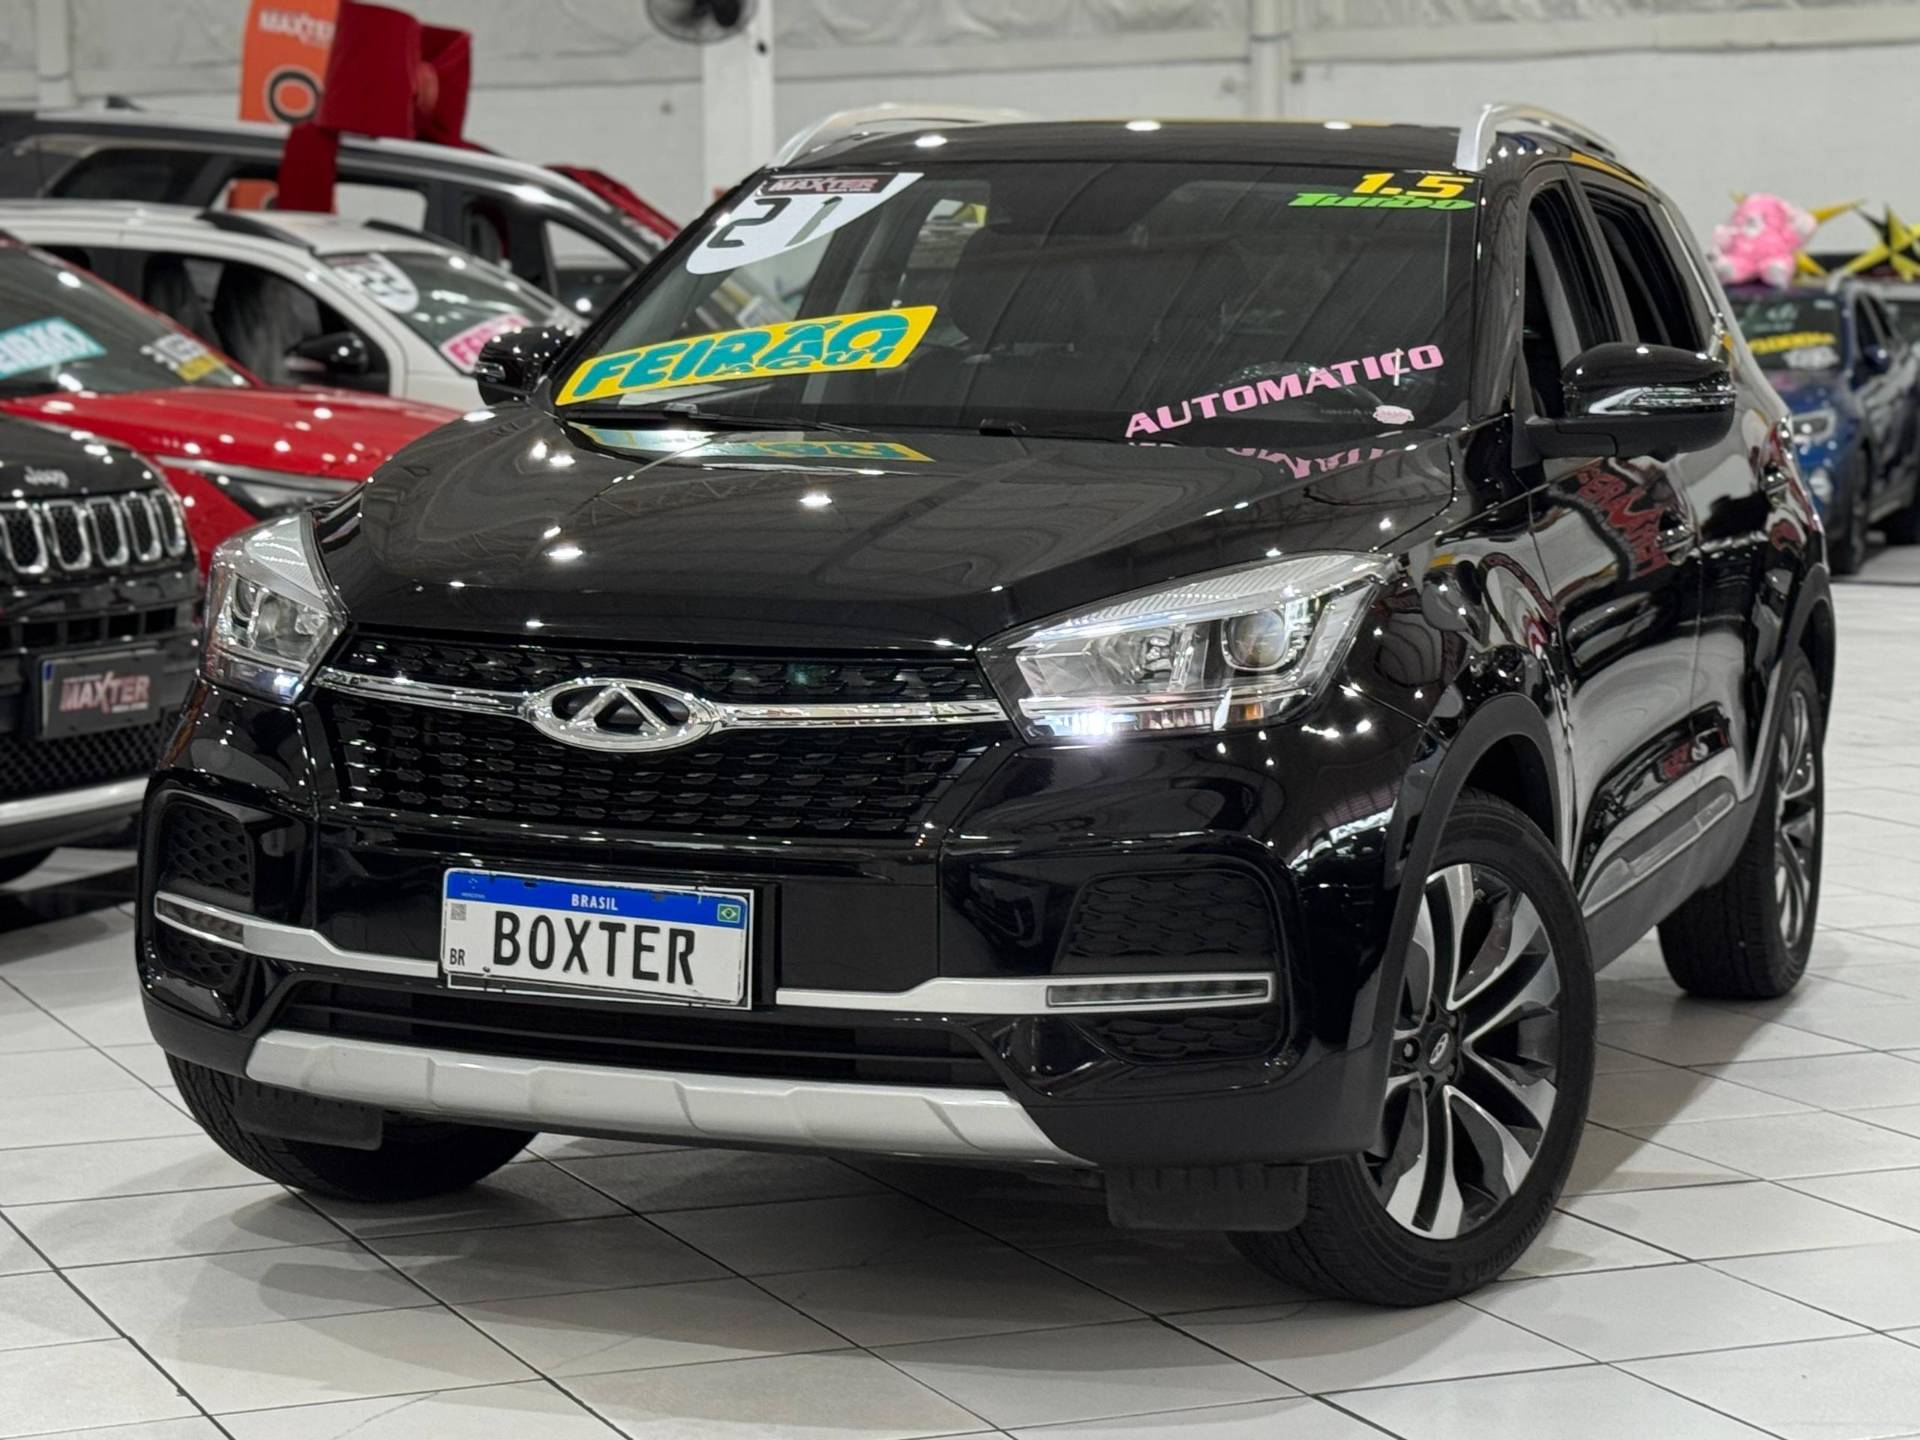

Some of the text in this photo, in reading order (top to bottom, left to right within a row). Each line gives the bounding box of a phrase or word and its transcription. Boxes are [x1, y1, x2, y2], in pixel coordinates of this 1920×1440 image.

[1352, 172, 1475, 199] 1.5
[707, 195, 843, 249] 21
[572, 313, 911, 397] FEIRÃO
[1124, 344, 1445, 439] AUTOMATICO
[59, 671, 150, 714] MAXTER
[571, 893, 619, 911] BRASIL
[449, 948, 466, 967] BR
[493, 909, 696, 985] BOXTER
